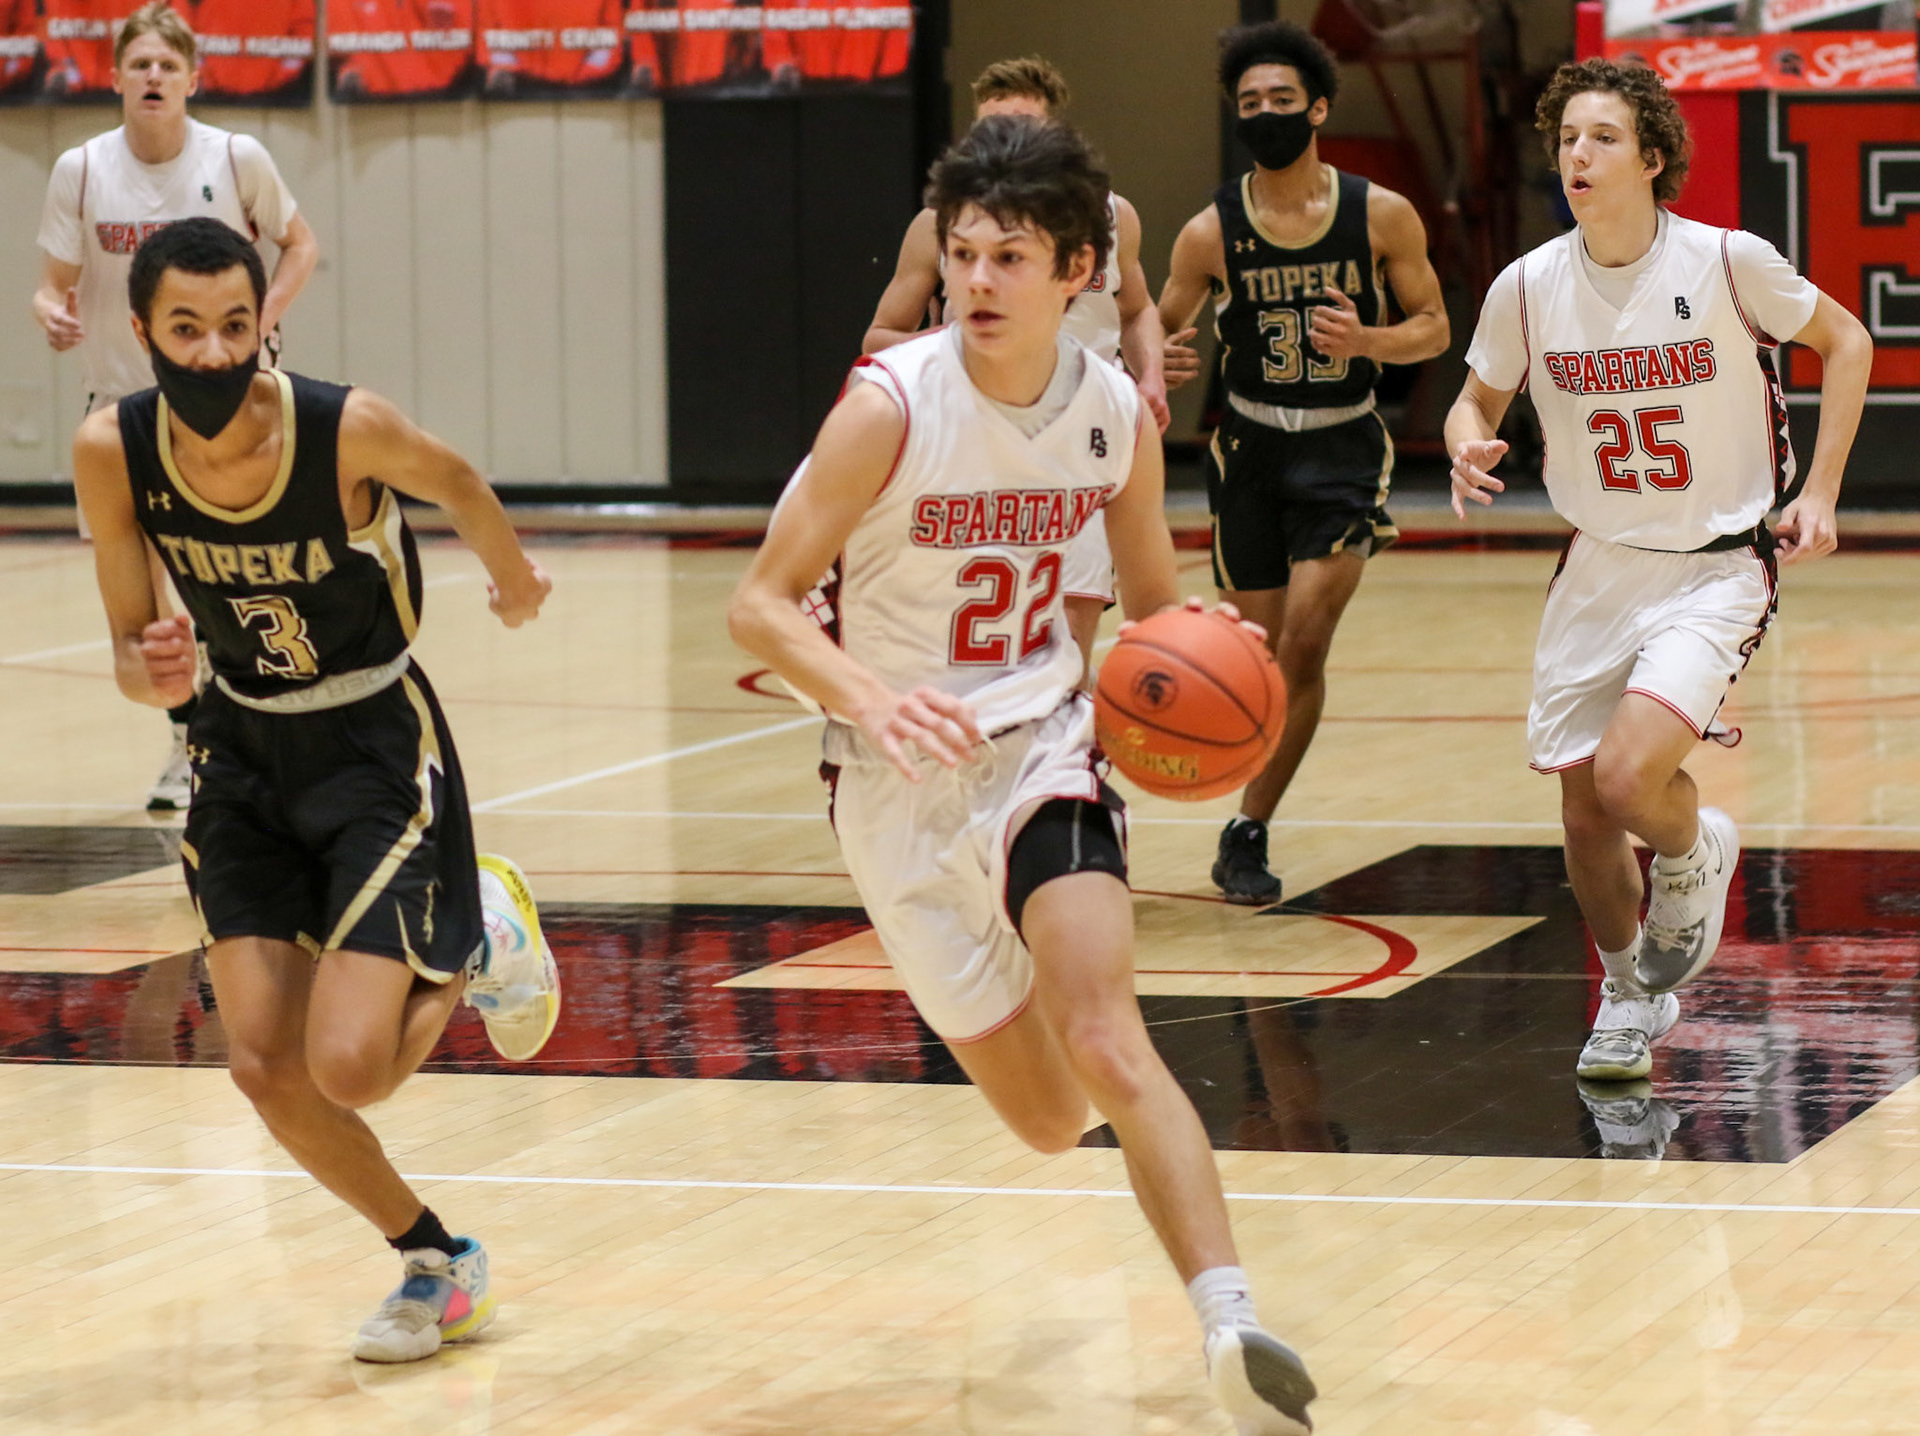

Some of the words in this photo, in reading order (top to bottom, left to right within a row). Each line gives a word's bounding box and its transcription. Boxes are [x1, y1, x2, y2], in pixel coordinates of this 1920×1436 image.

[1240, 260, 1363, 303] TOPEKA
[1258, 307, 1350, 383] 35
[1544, 338, 1717, 395] SPARTANS
[1587, 405, 1693, 494] 25
[156, 533, 336, 585] TOPEKA
[226, 594, 319, 680] 3
[949, 550, 1064, 666] 22
